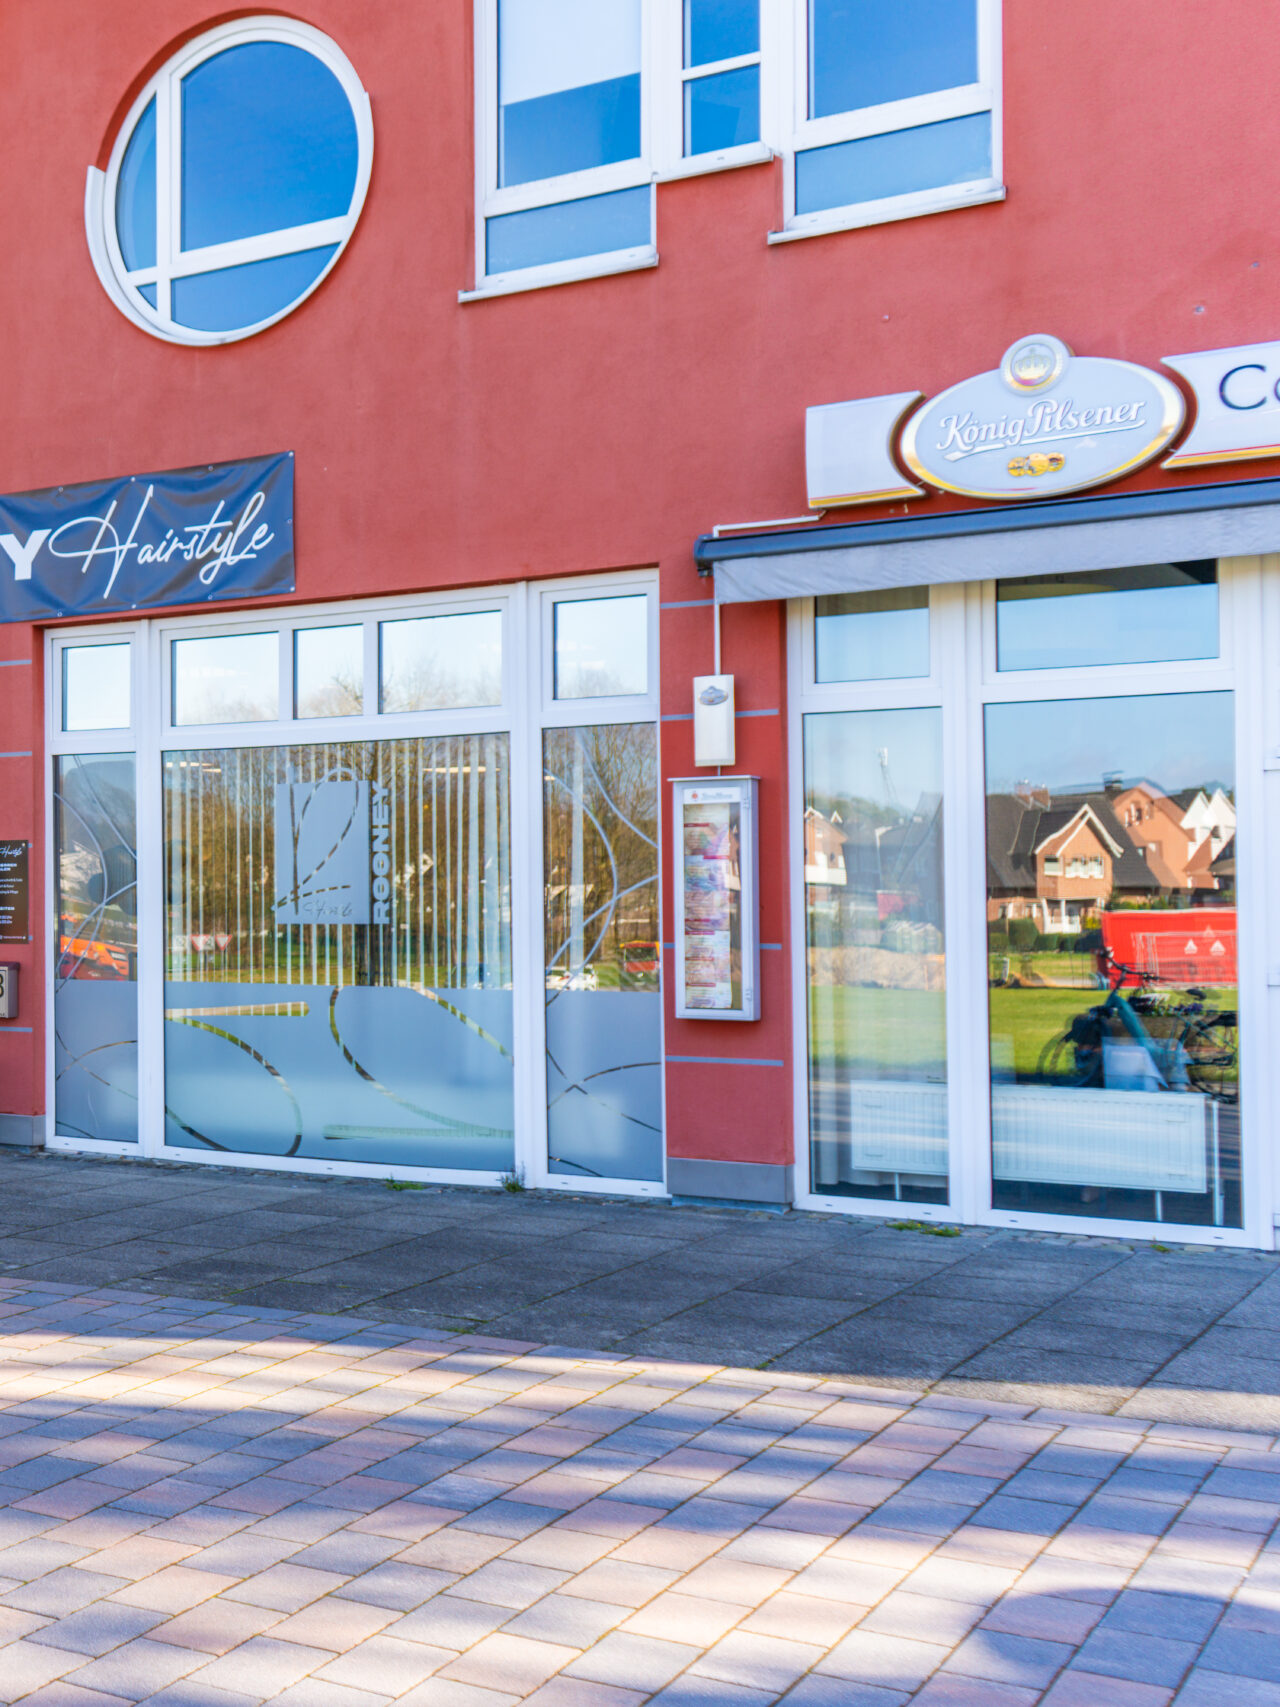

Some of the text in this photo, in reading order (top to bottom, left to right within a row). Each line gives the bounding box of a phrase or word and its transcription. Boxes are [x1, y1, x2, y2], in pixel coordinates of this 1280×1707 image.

[936, 399, 1147, 452] König Pilsener
[1218, 363, 1280, 411] C
[48, 484, 275, 600] Hairstyle
[372, 781, 391, 925] ROONEY
